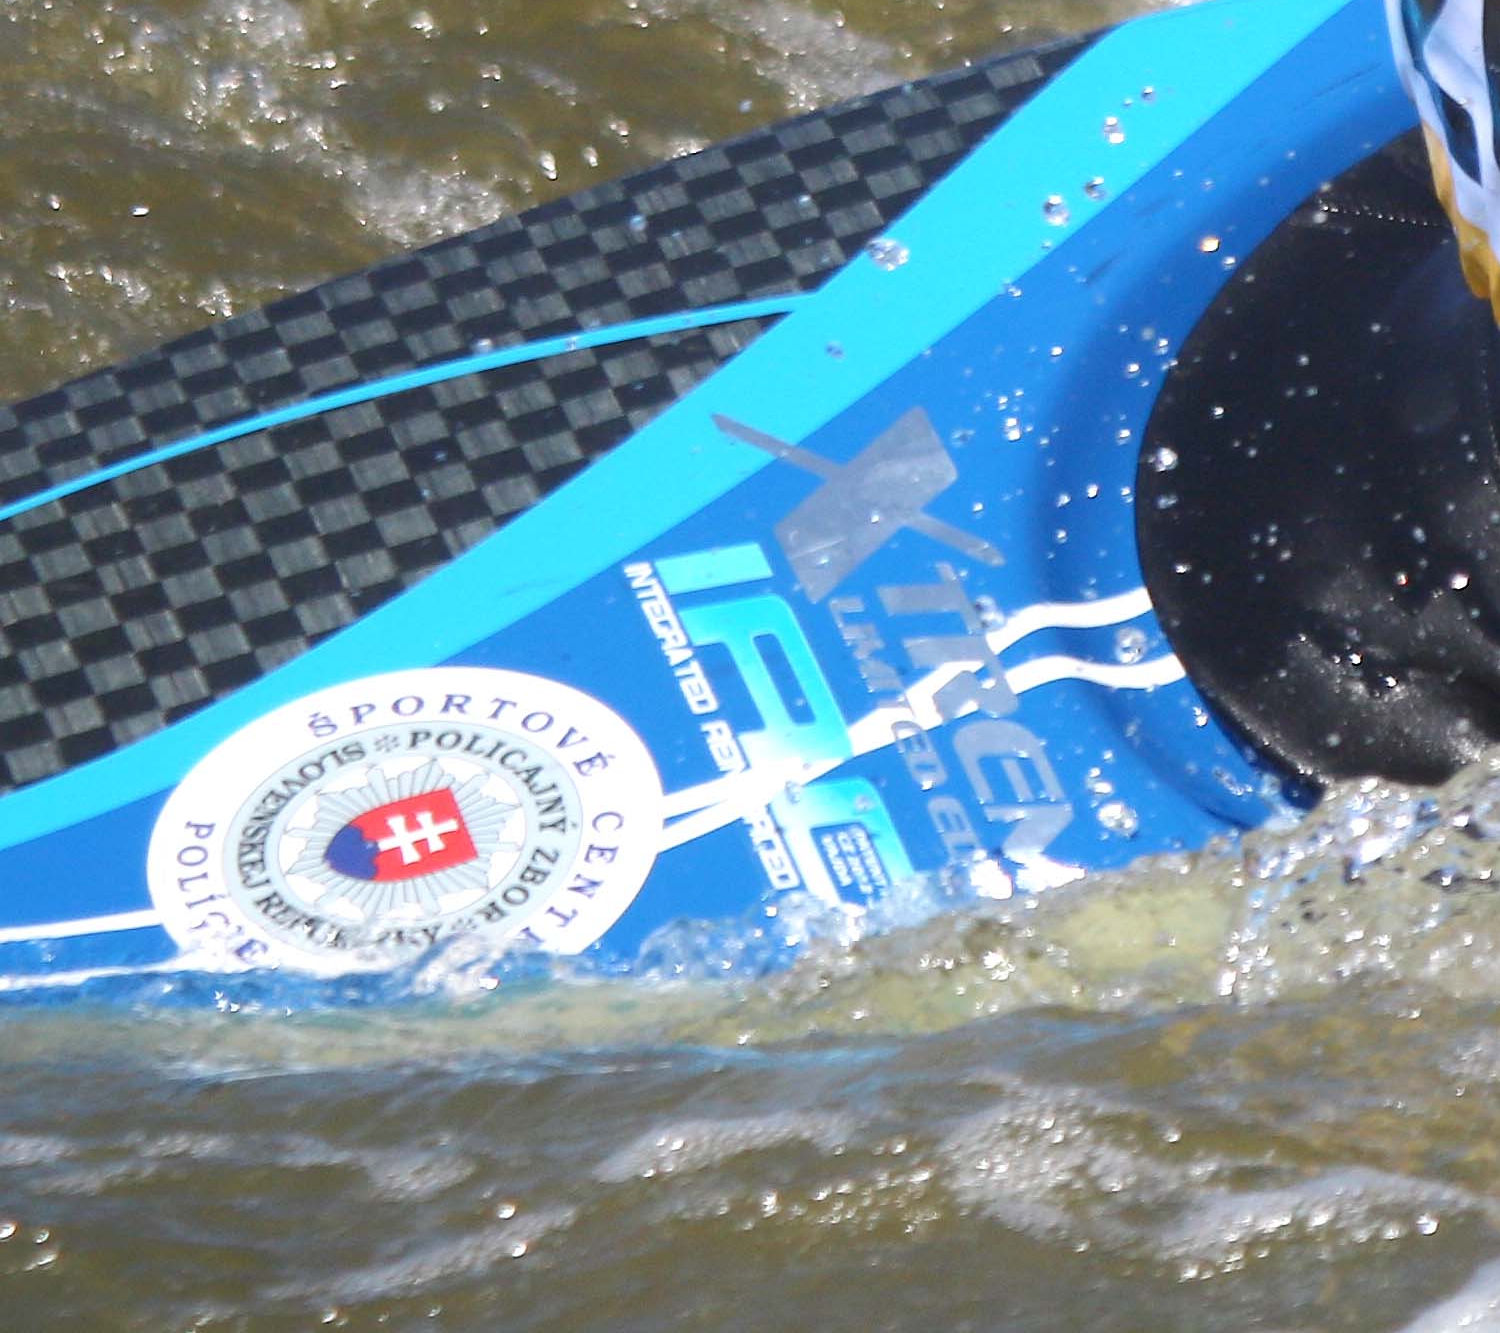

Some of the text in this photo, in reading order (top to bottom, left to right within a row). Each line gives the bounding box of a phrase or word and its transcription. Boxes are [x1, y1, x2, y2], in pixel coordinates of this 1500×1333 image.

[307, 693, 617, 779] ŠPORTOVÉ
[623, 560, 800, 891] INTEGRATED REINRCED
[237, 741, 366, 890] SLOVENSKEJ
[408, 728, 579, 924] POLICAJNÝ ZBOR
